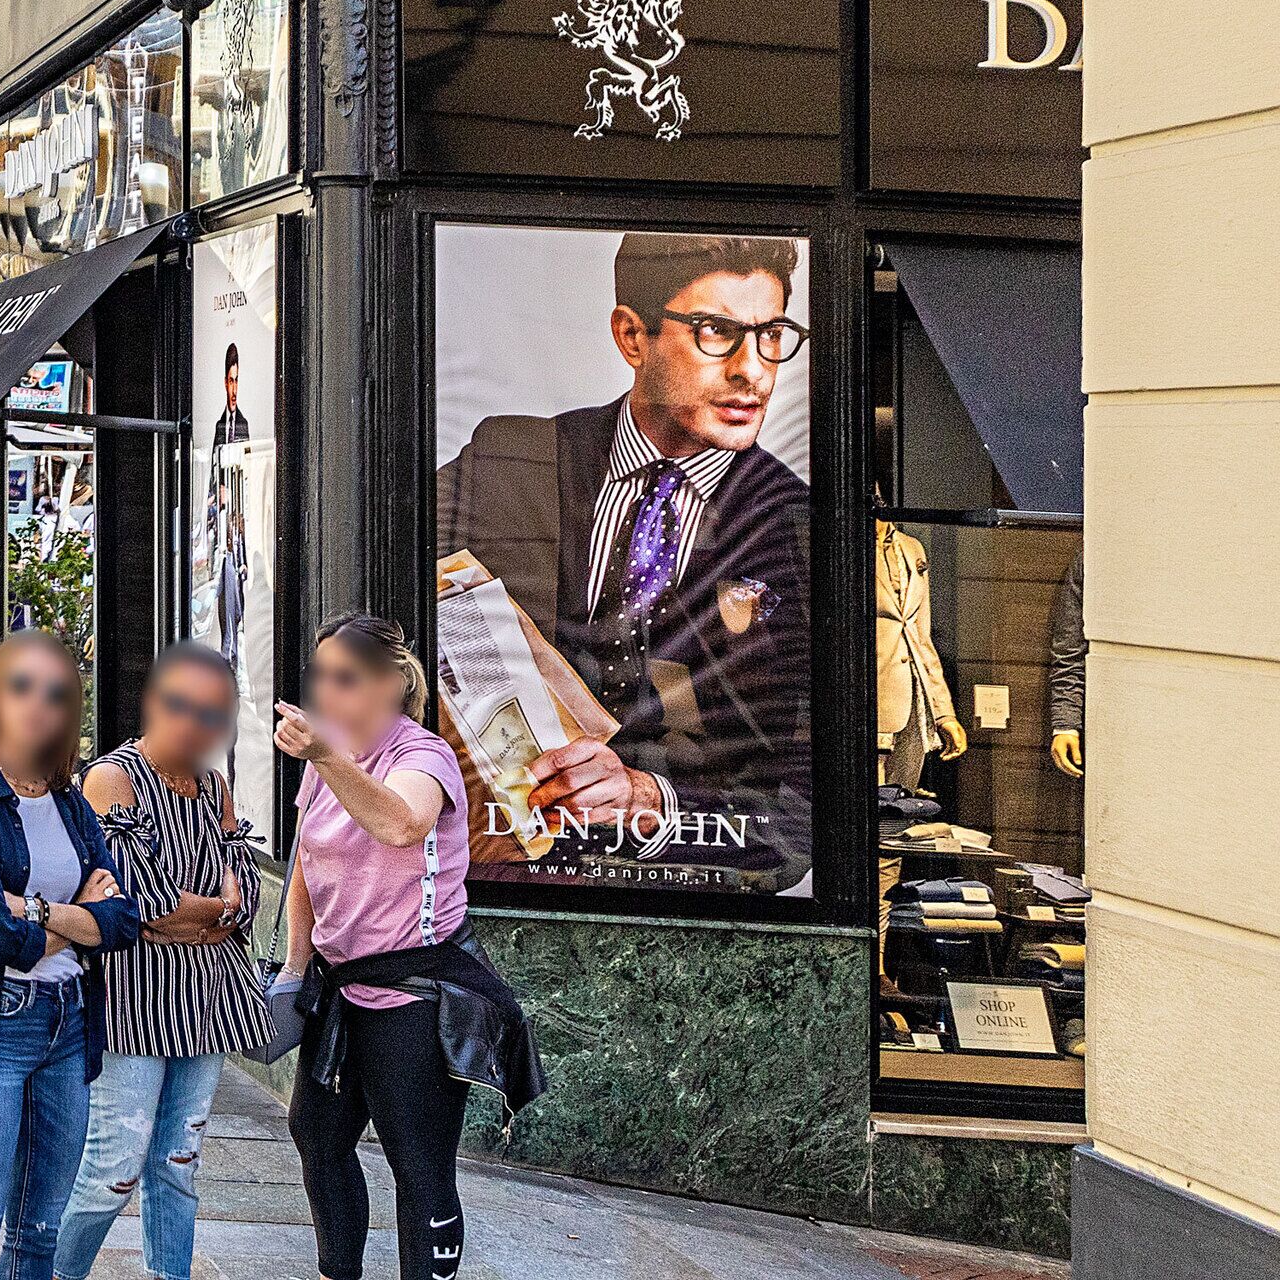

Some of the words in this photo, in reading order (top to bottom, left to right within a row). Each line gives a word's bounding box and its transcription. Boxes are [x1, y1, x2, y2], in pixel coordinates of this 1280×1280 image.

[3, 132, 44, 199] DAN
[38, 102, 100, 199] JOHN
[213, 293, 228, 312] DAN
[227, 290, 248, 314] JOHN
[483, 801, 593, 841] DAN
[979, 999, 1016, 1012] SHOP
[975, 1014, 1028, 1029] ONLINE
